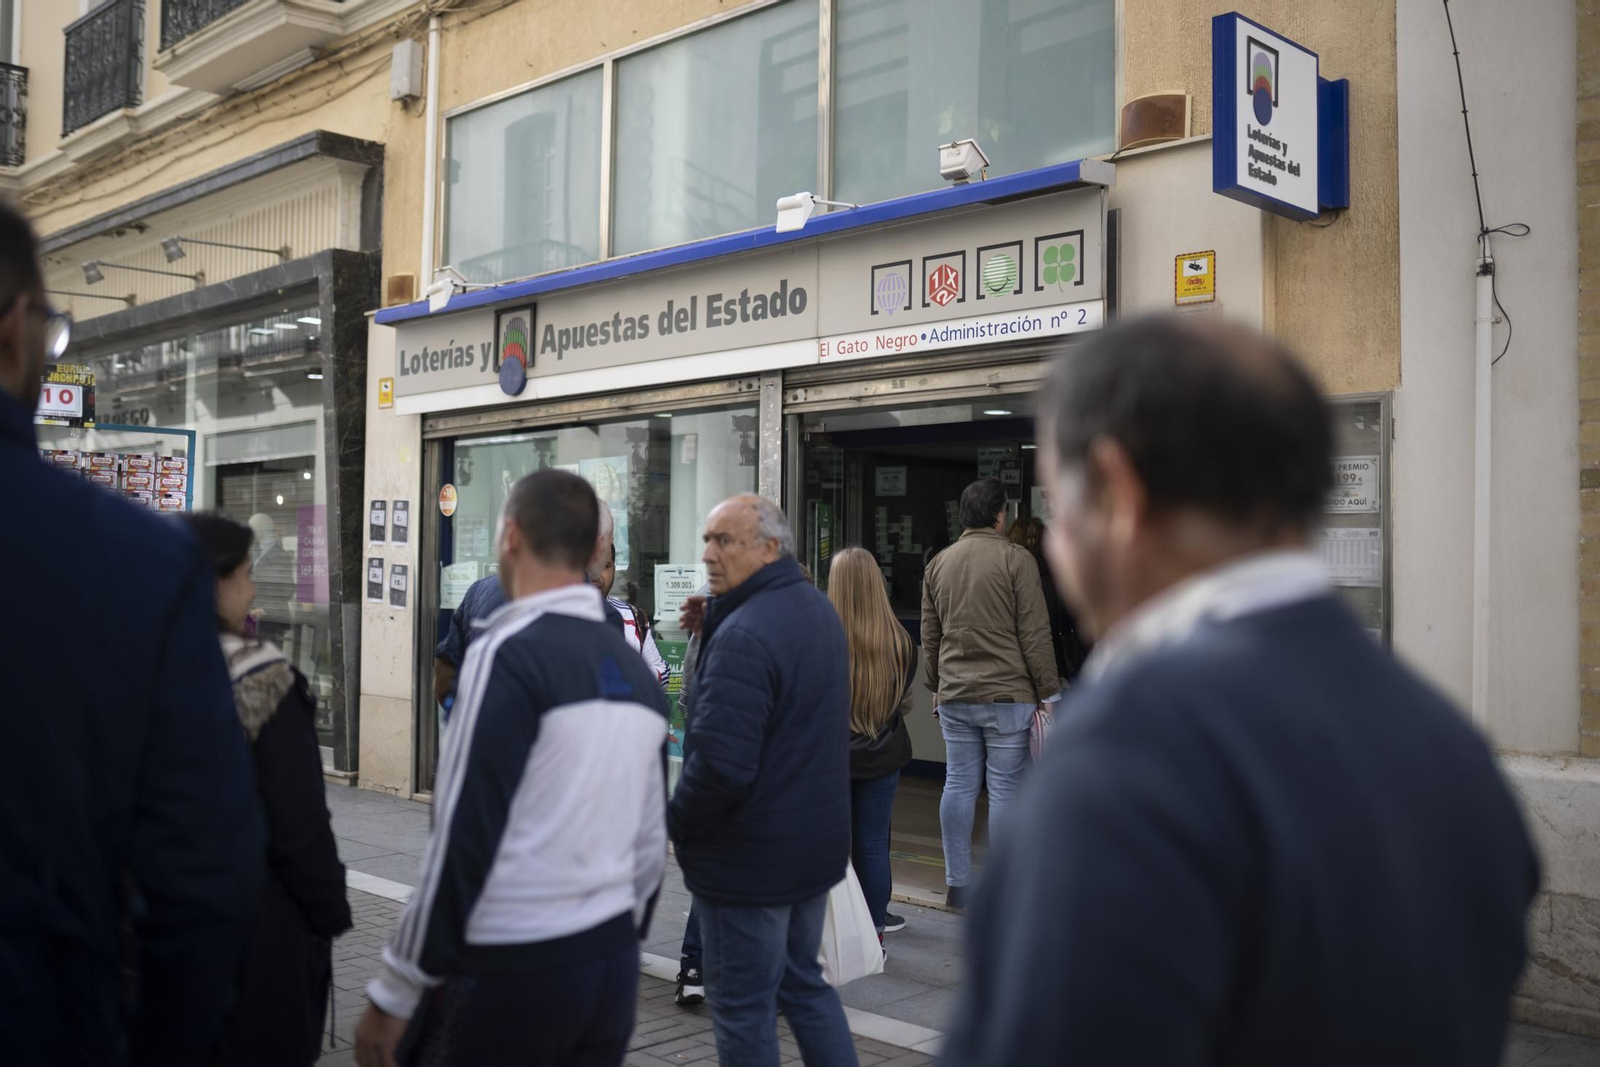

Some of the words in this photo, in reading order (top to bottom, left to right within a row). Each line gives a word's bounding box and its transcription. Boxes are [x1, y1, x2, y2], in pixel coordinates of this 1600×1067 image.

[1247, 123, 1281, 151] Loterías
[1282, 142, 1288, 158] y
[1248, 144, 1286, 171] Apuestas
[1287, 160, 1301, 178] del
[1248, 162, 1278, 186] Estado
[400, 339, 474, 377] Loterías
[480, 341, 492, 373] y
[540, 310, 650, 361] Apuestas
[658, 295, 697, 336] del
[706, 279, 808, 328] Estado
[820, 341, 830, 357] El
[837, 339, 869, 356] Gato
[875, 334, 918, 352] Negro
[929, 315, 1042, 344] Administración
[1077, 308, 1087, 325] 2
[1338, 463, 1369, 471] PREMIO
[1348, 497, 1367, 506] AQUÍ
